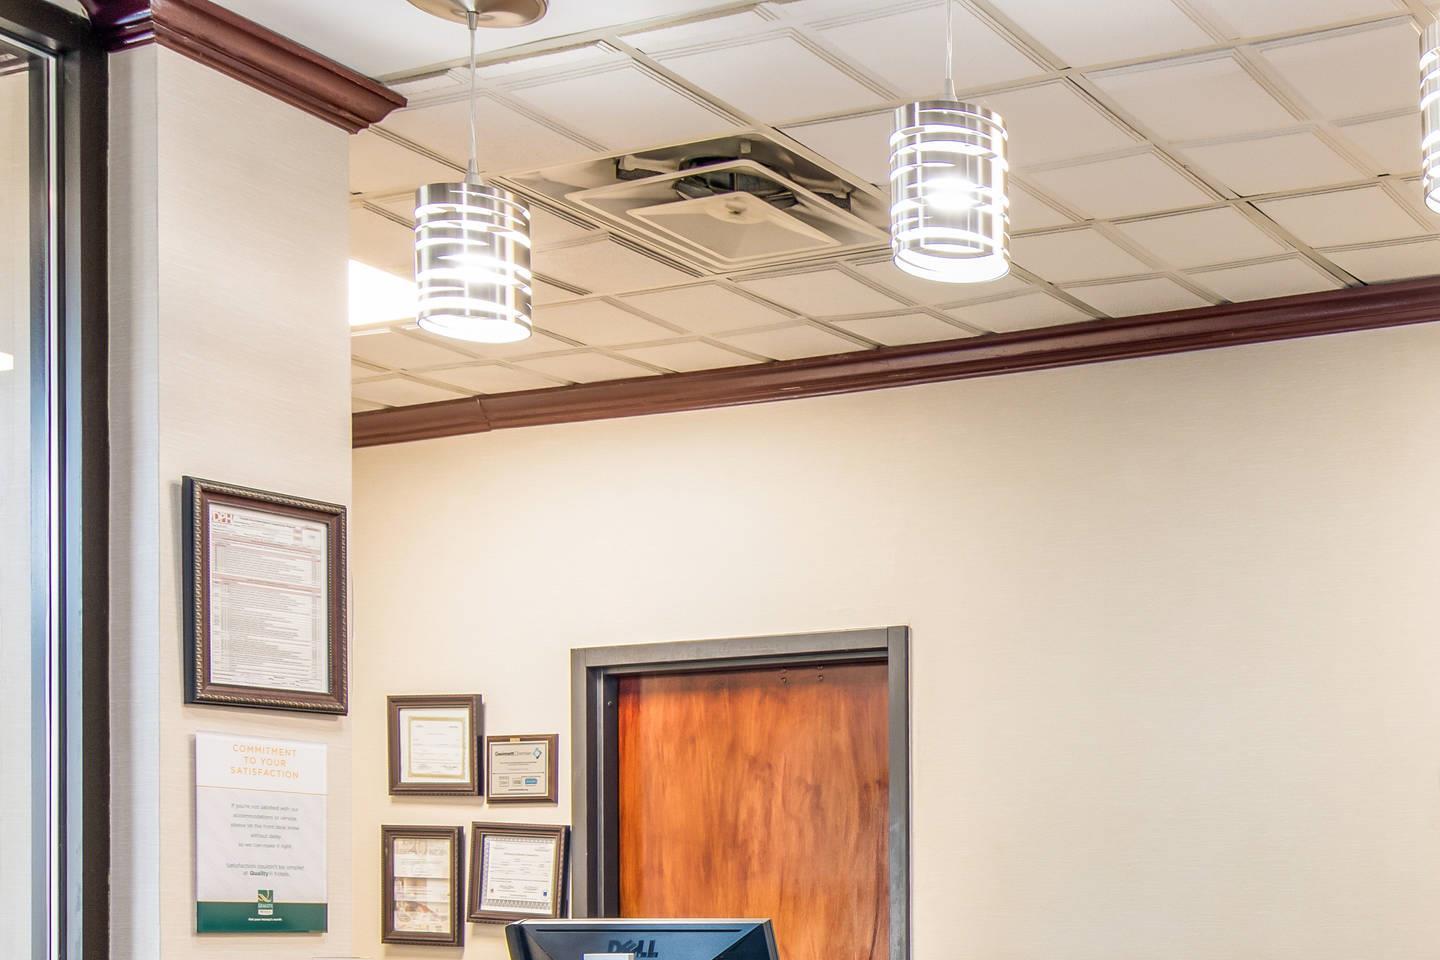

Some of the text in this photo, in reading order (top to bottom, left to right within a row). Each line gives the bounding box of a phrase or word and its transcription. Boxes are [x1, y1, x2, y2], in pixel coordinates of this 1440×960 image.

[232, 744, 297, 757] COMMITMENT
[244, 756, 287, 767] TO YOUR
[230, 766, 299, 780] SATISFACTION
[608, 940, 659, 958] DELL
